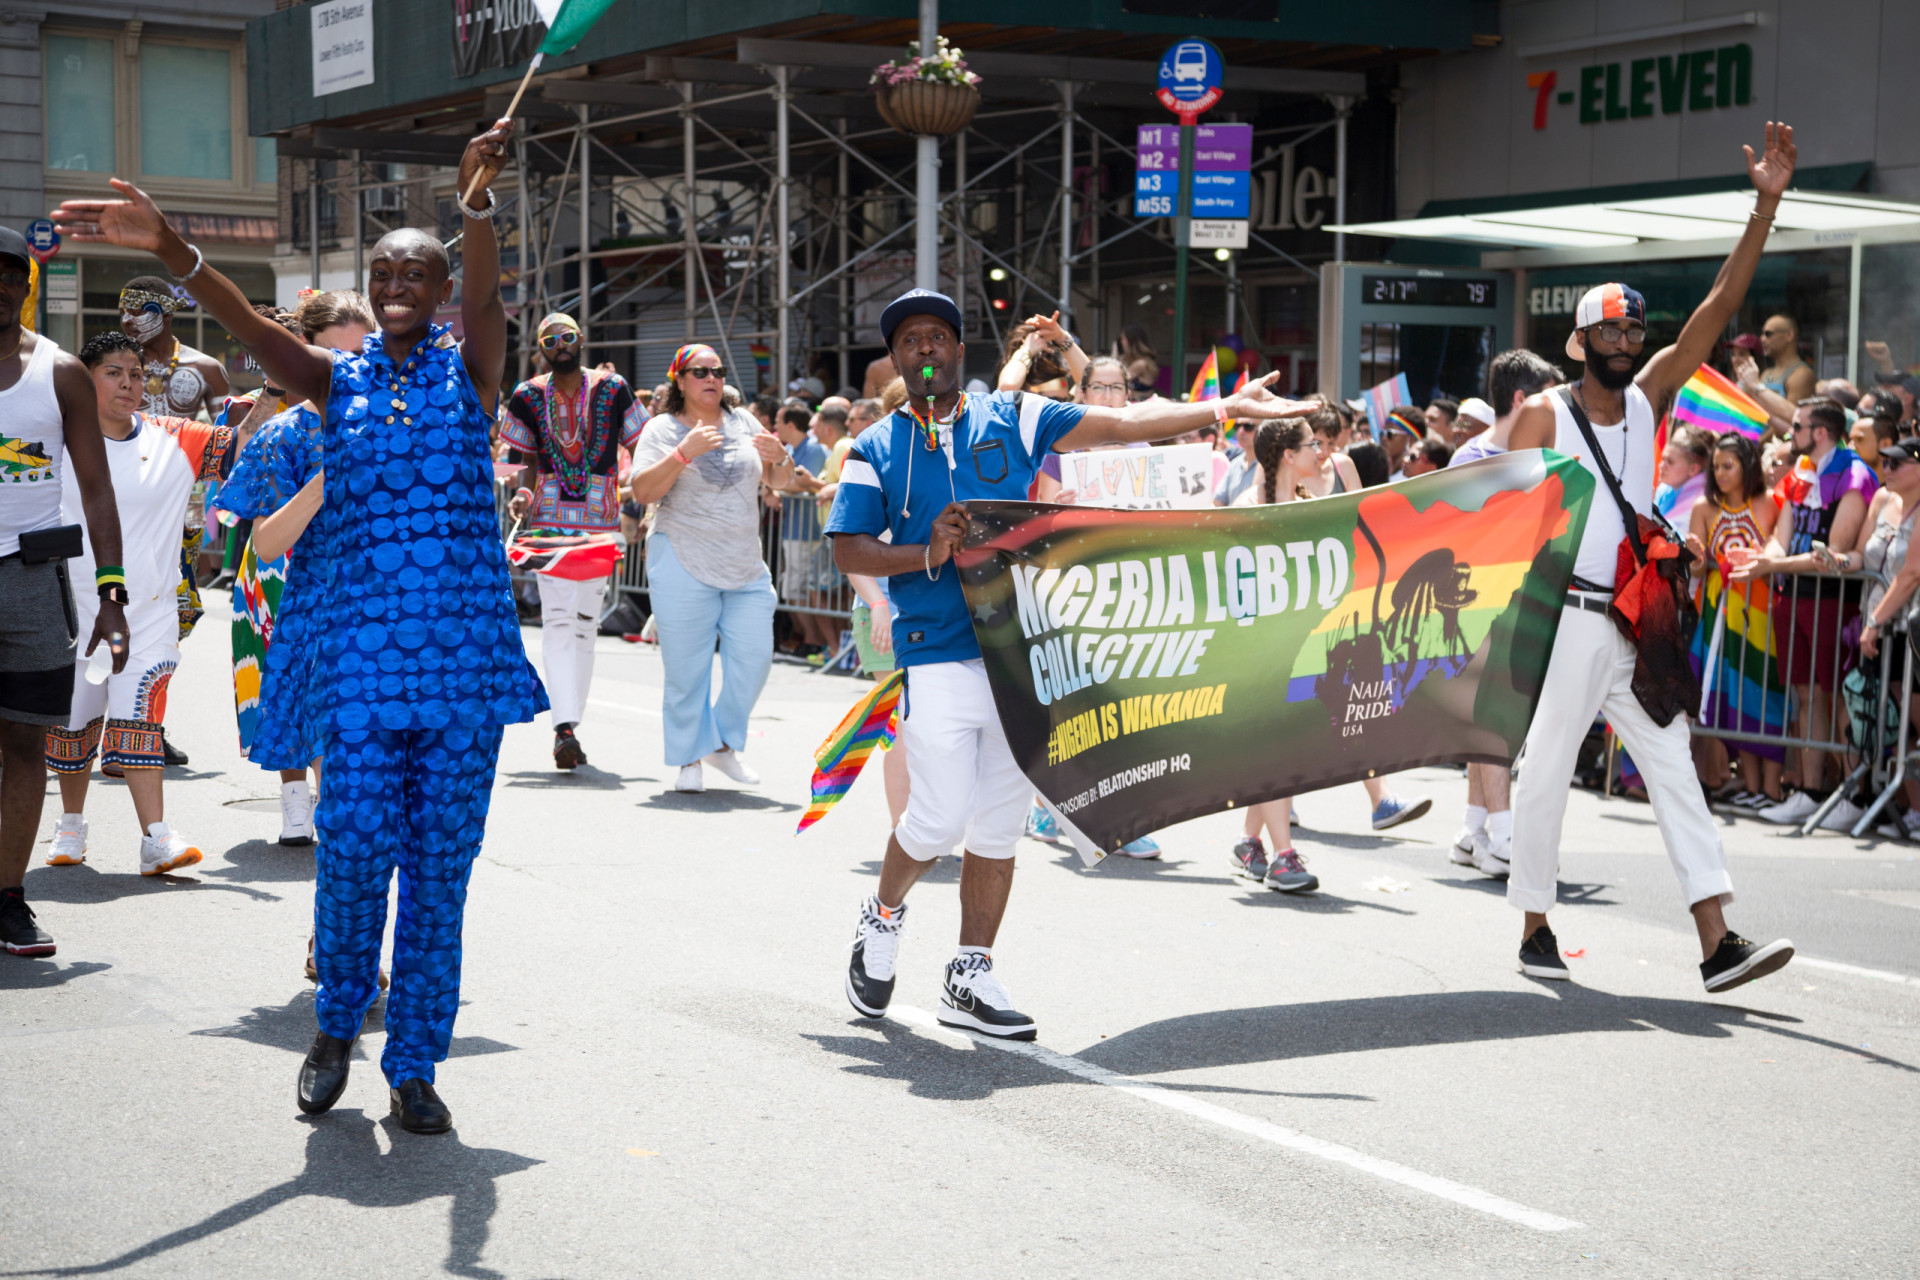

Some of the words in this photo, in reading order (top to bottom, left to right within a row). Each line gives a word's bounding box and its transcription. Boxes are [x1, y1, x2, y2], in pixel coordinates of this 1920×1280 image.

[1161, 91, 1175, 106] NO
[1174, 90, 1217, 111] STANDING
[1140, 128, 1162, 145] M1
[1140, 151, 1164, 169] M2
[1212, 151, 1236, 162] Village
[1138, 174, 1162, 192] M3
[1212, 175, 1236, 186] Village
[1137, 196, 1171, 214] M55
[1179, 466, 1206, 496] is
[1010, 554, 1195, 640] NIGERIA
[1203, 537, 1349, 627] LGBTQ
[1030, 629, 1216, 706] COLLECTIVE
[1348, 680, 1393, 702] NAIJA
[1344, 700, 1393, 723] PRIDE
[1048, 708, 1102, 767] #NIGERIA
[1100, 702, 1118, 742] IS
[1120, 684, 1228, 736] WAKANDA
[1342, 724, 1363, 738] USA
[1098, 759, 1168, 799] RELATIONSHIP
[1170, 753, 1190, 774] HQ
